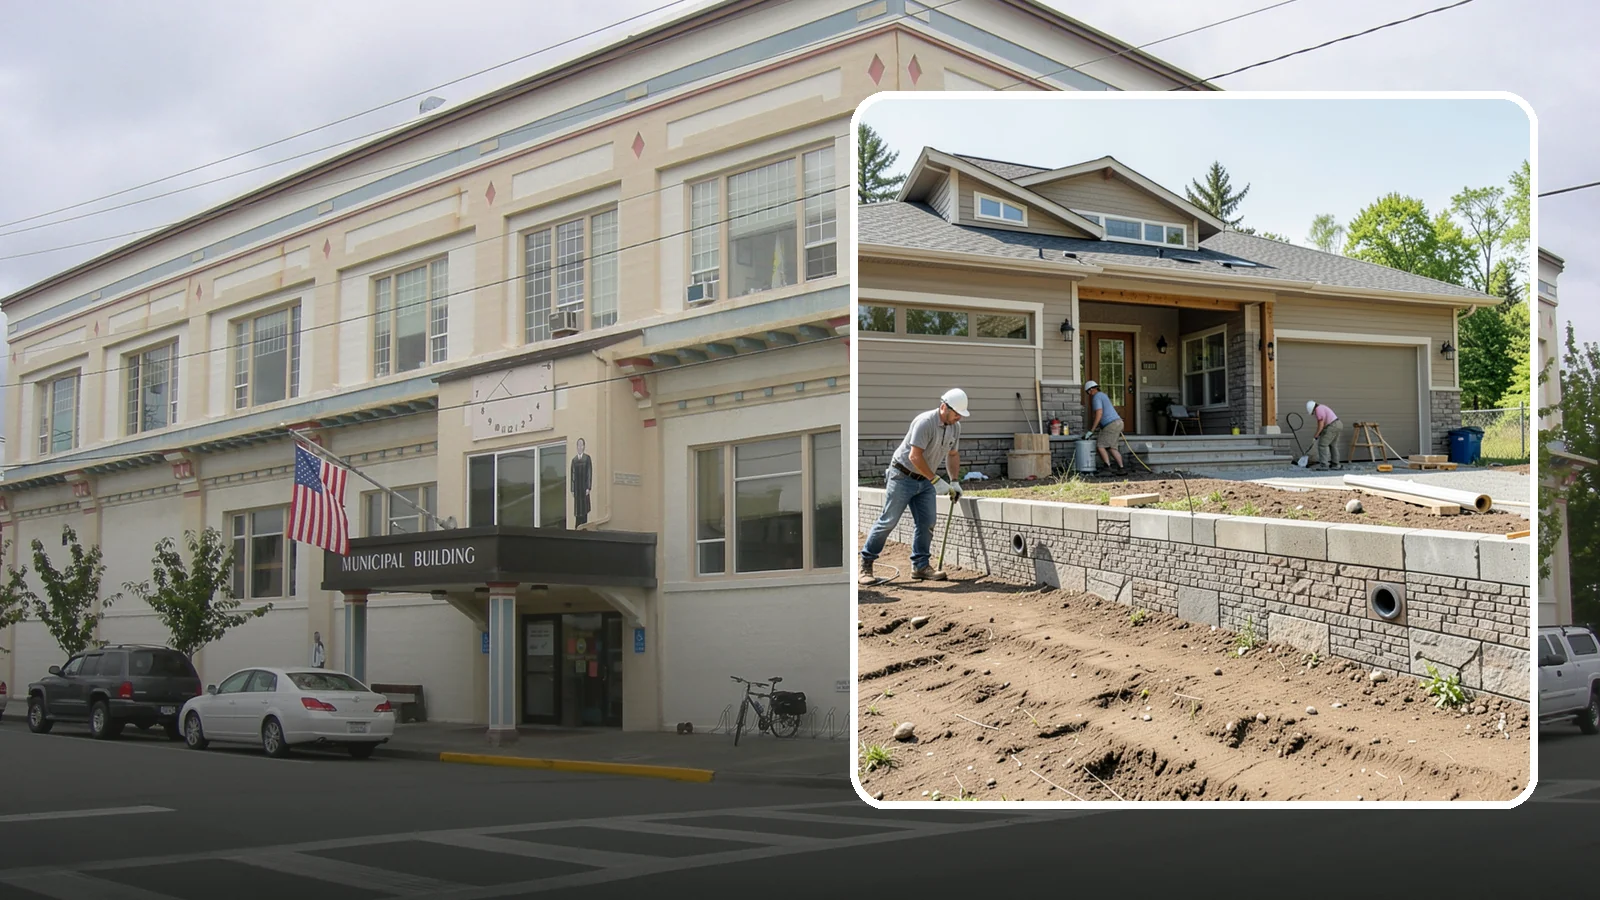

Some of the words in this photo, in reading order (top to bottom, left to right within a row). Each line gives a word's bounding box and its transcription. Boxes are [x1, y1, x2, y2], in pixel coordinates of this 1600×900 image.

[547, 361, 551, 370] 6
[475, 390, 479, 398] 7
[536, 402, 540, 410] 4
[481, 407, 485, 415] 8
[488, 417, 492, 426] 9
[529, 414, 533, 422] 3
[521, 420, 525, 428] 2
[501, 425, 506, 433] 11
[507, 425, 513, 433] 12
[342, 552, 405, 572] MUNICIPAL
[414, 546, 475, 567] BUILDING
